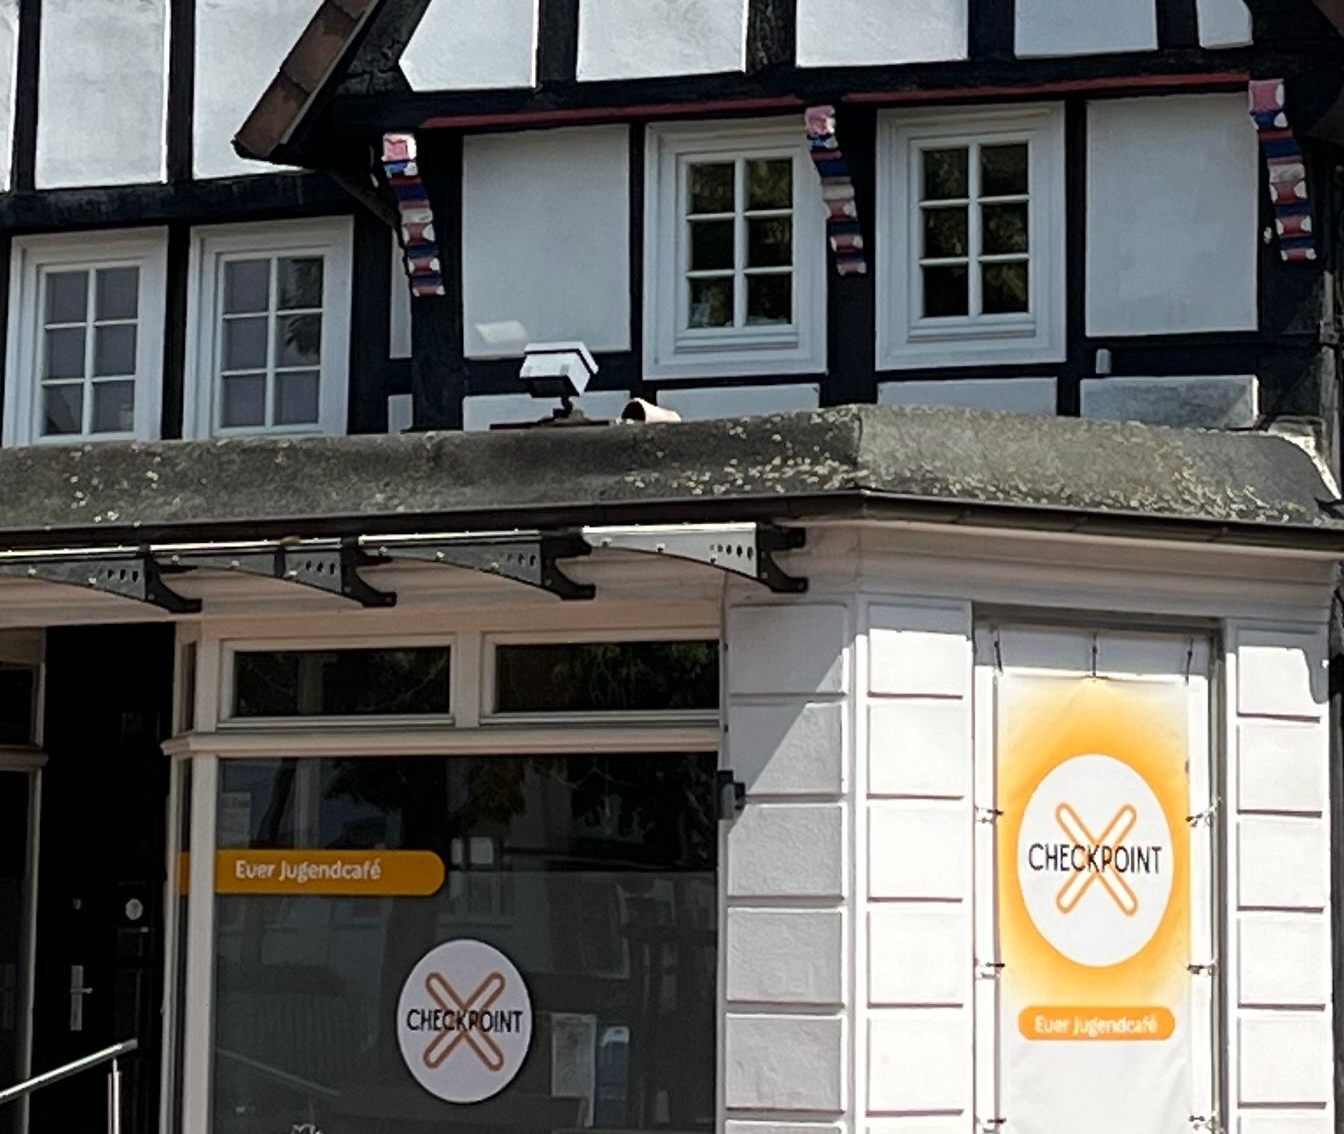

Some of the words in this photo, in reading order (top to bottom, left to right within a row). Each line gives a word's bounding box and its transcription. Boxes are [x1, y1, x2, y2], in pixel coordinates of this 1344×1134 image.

[1028, 842, 1163, 874] CHECKPOINT
[235, 859, 275, 879] Euer
[278, 858, 381, 883] Jugendcafé
[407, 1009, 523, 1033] CHECKPOINT
[1035, 1015, 1069, 1034] Euer
[1072, 1014, 1159, 1038] Jugendcafé
